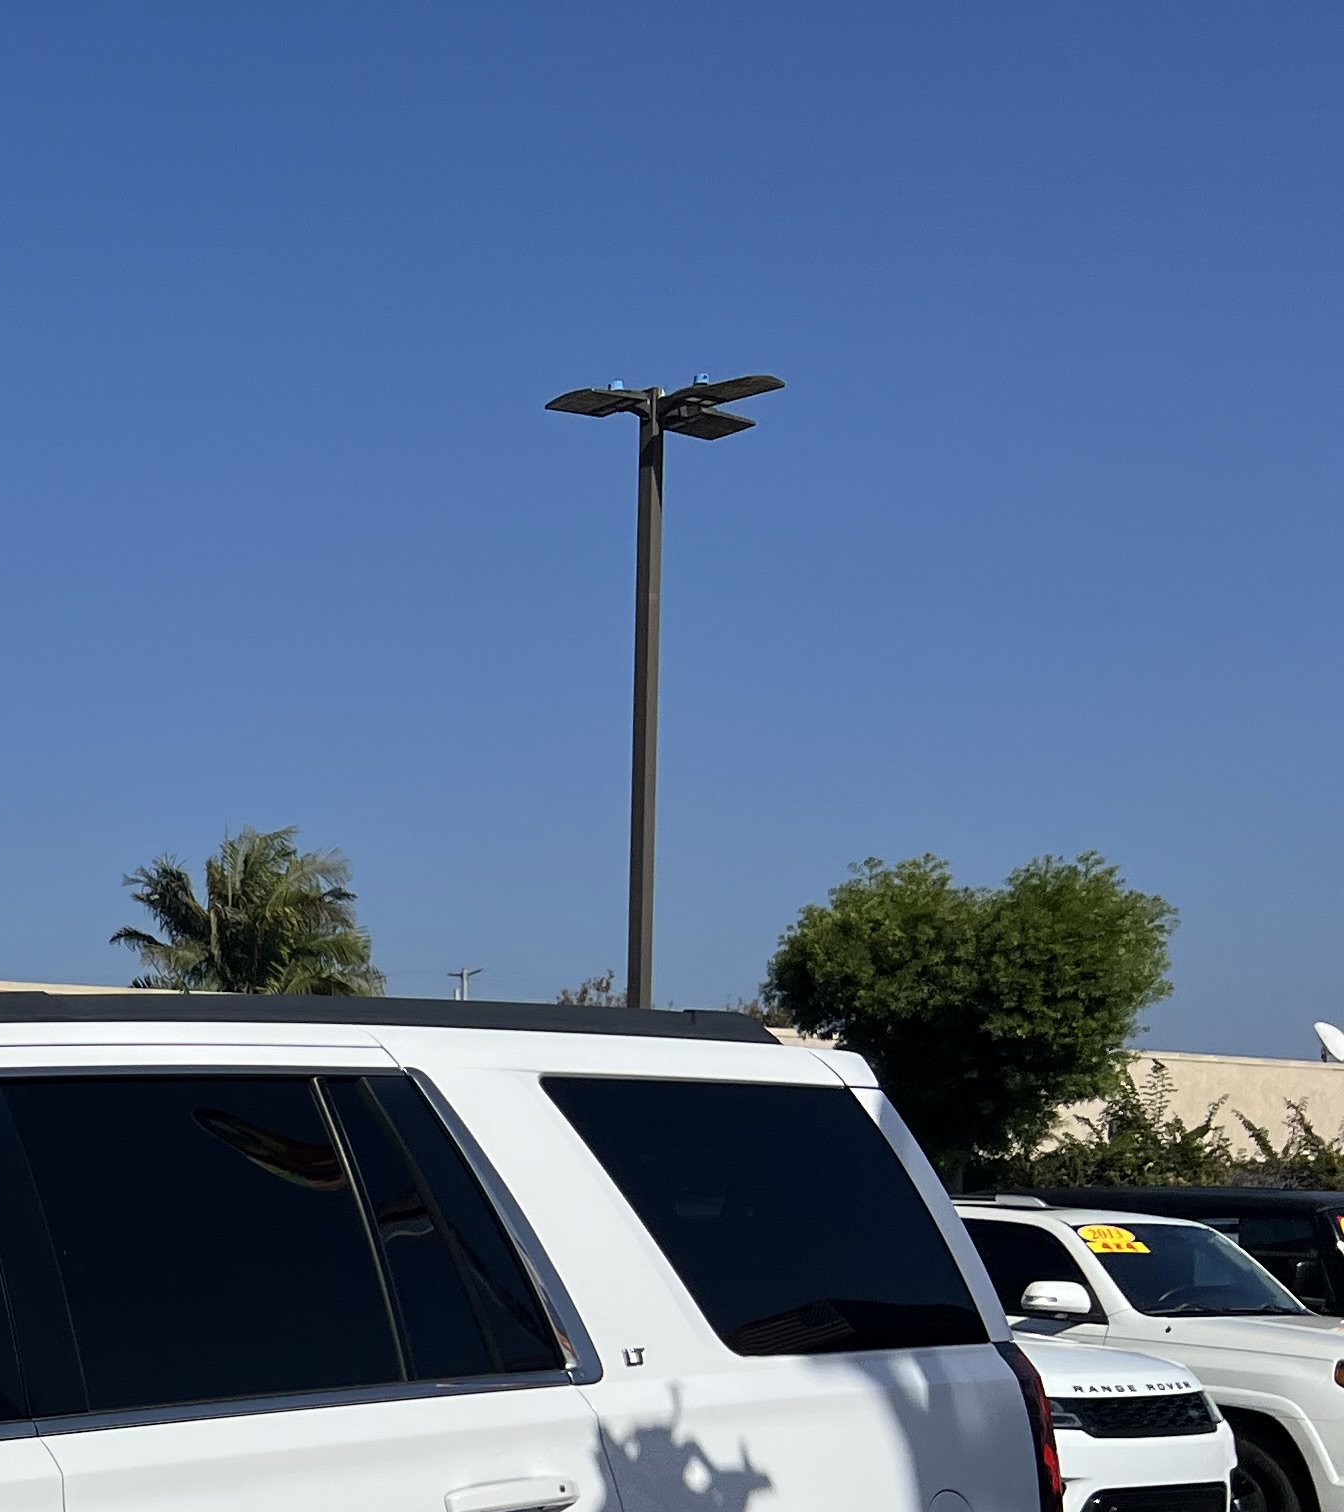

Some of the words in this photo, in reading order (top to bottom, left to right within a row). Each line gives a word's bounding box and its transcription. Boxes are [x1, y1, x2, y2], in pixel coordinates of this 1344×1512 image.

[621, 1347, 645, 1368] LT
[1072, 1384, 1137, 1393] RANGE
[1145, 1380, 1192, 1391] ROVER
